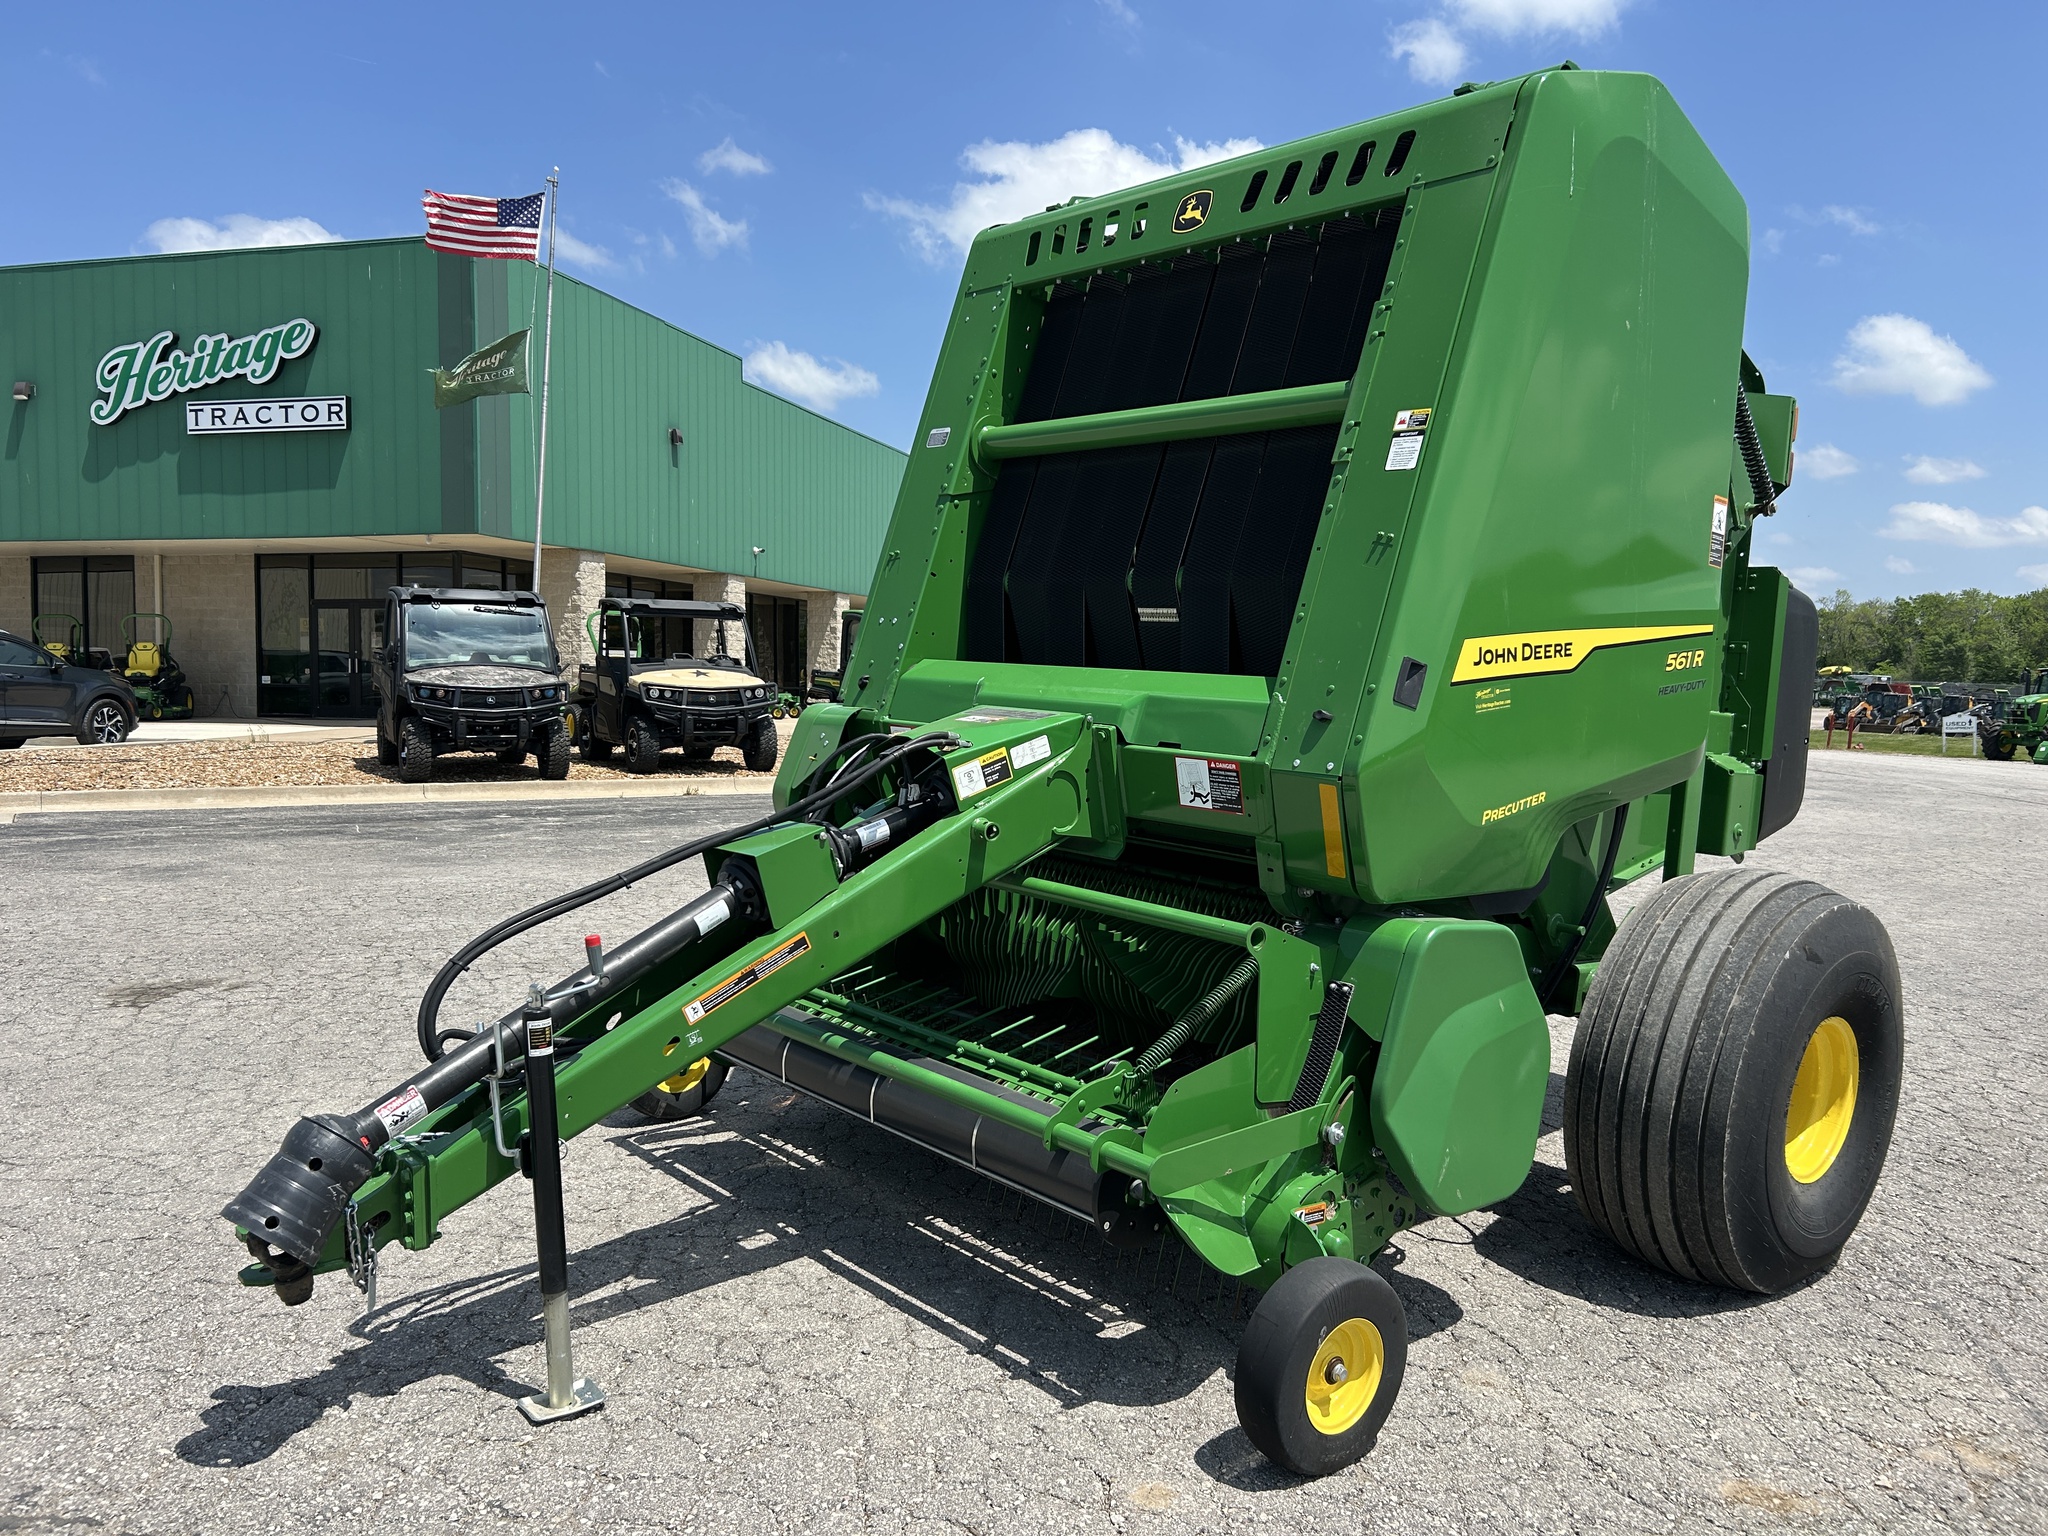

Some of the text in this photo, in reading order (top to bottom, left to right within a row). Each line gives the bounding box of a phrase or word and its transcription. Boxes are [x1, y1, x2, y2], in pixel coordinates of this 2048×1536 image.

[91, 319, 315, 425] Heritage
[189, 403, 344, 427] TRACTOR
[1473, 642, 1573, 666] JOHN DEERE
[1658, 680, 1707, 696] HEAVY-DUTY
[1215, 762, 1236, 770] DANGER
[1481, 791, 1546, 826] PRECUTTER
